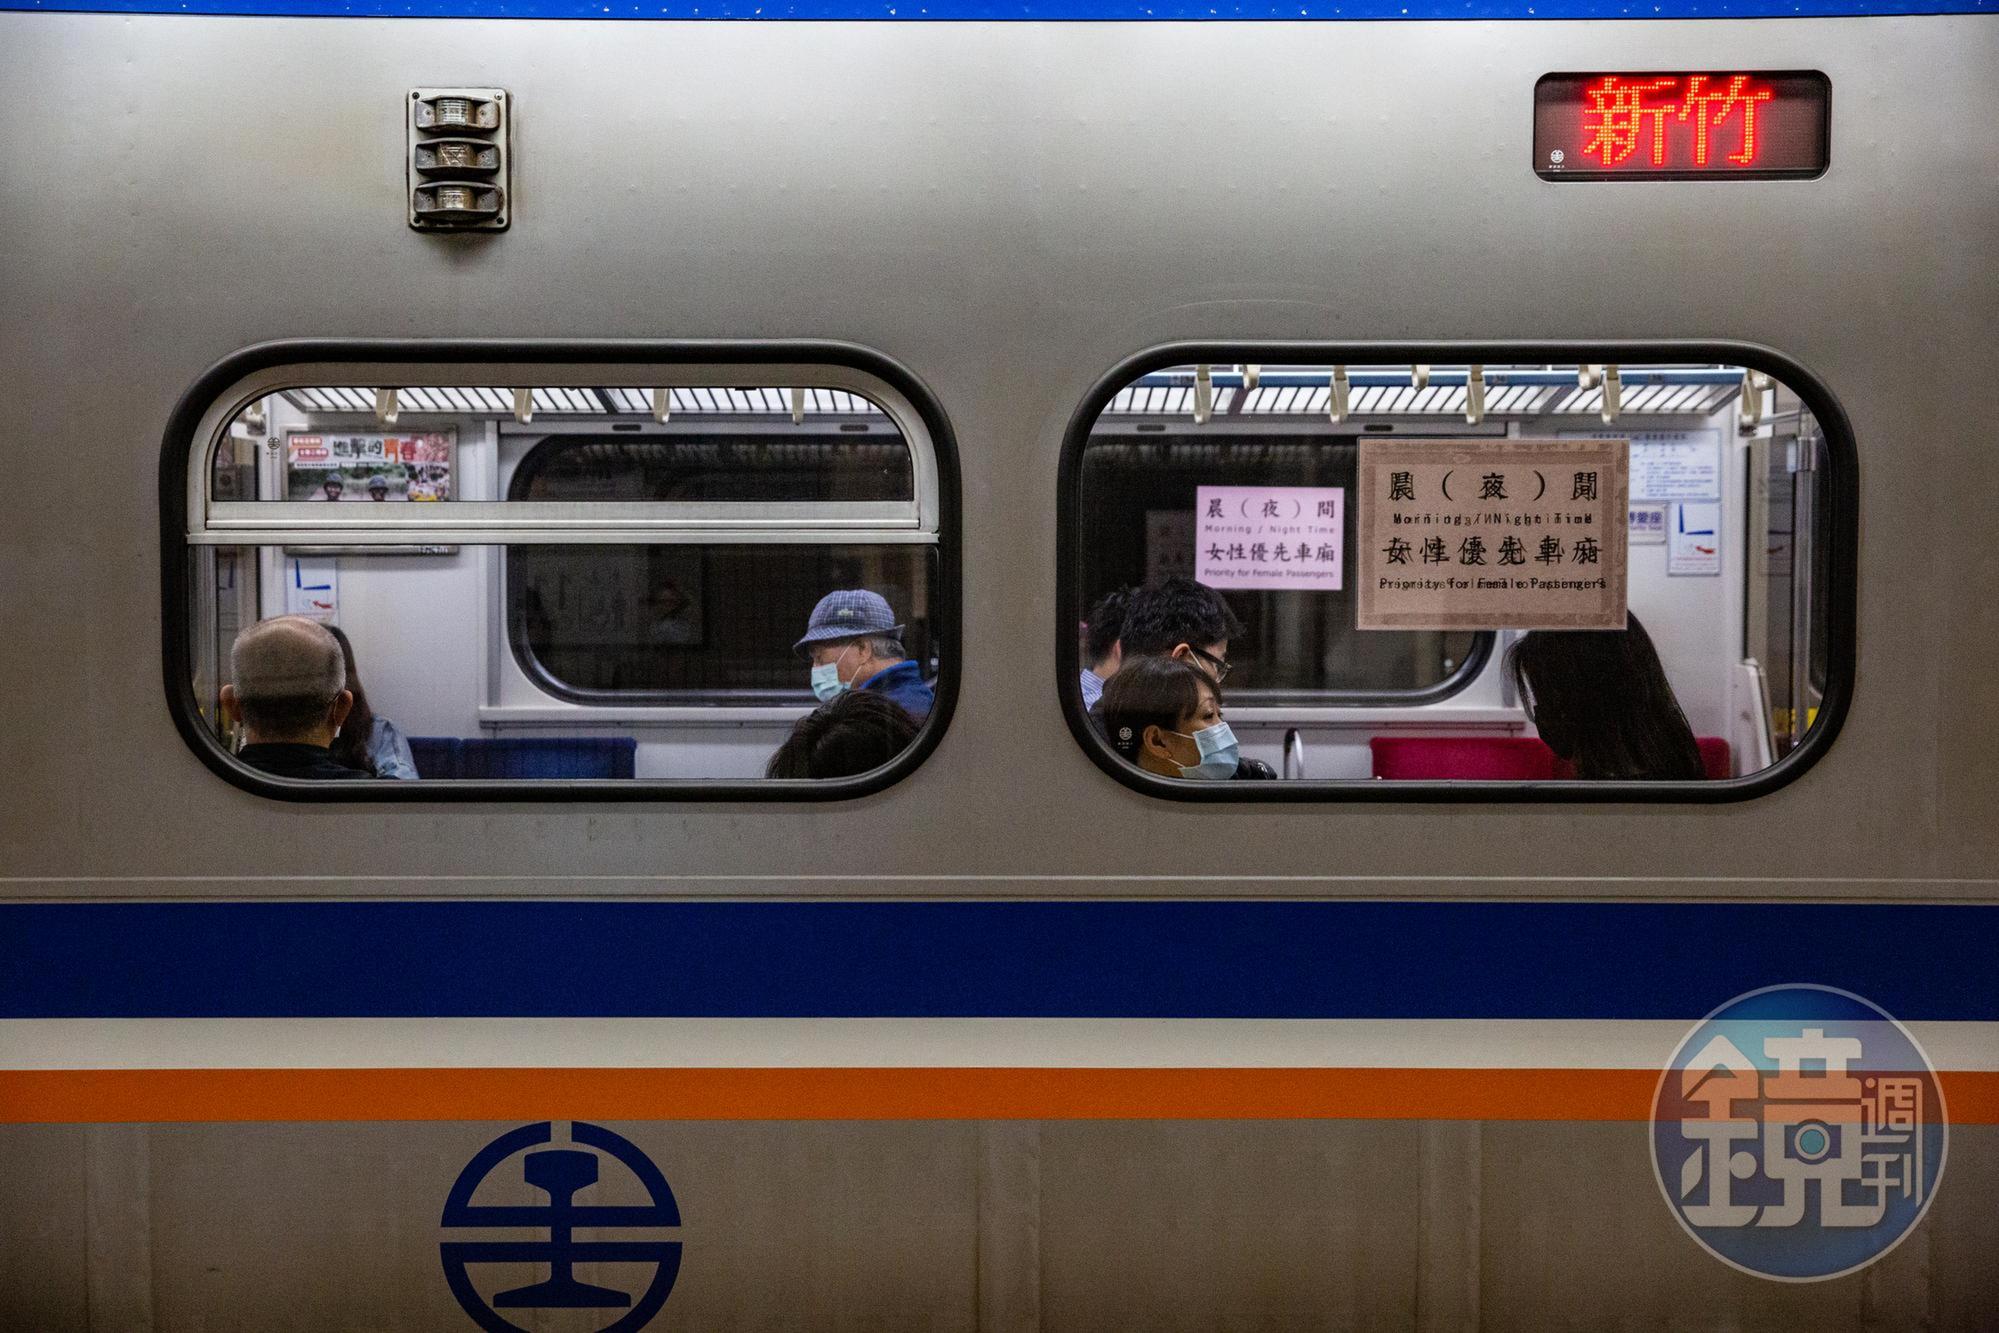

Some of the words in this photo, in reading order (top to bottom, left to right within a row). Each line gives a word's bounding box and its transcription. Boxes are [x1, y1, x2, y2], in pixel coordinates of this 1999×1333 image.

[1583, 75, 1771, 165] 新竹
[1204, 525, 1252, 534] Morning
[1269, 525, 1301, 534] Night
[1308, 525, 1335, 533] Time
[1204, 542, 1335, 563] 女性優先車廂
[1204, 568, 1235, 578] Priority
[1238, 568, 1250, 577] for
[1253, 568, 1283, 577] Female
[1286, 569, 1334, 578] Passengers
